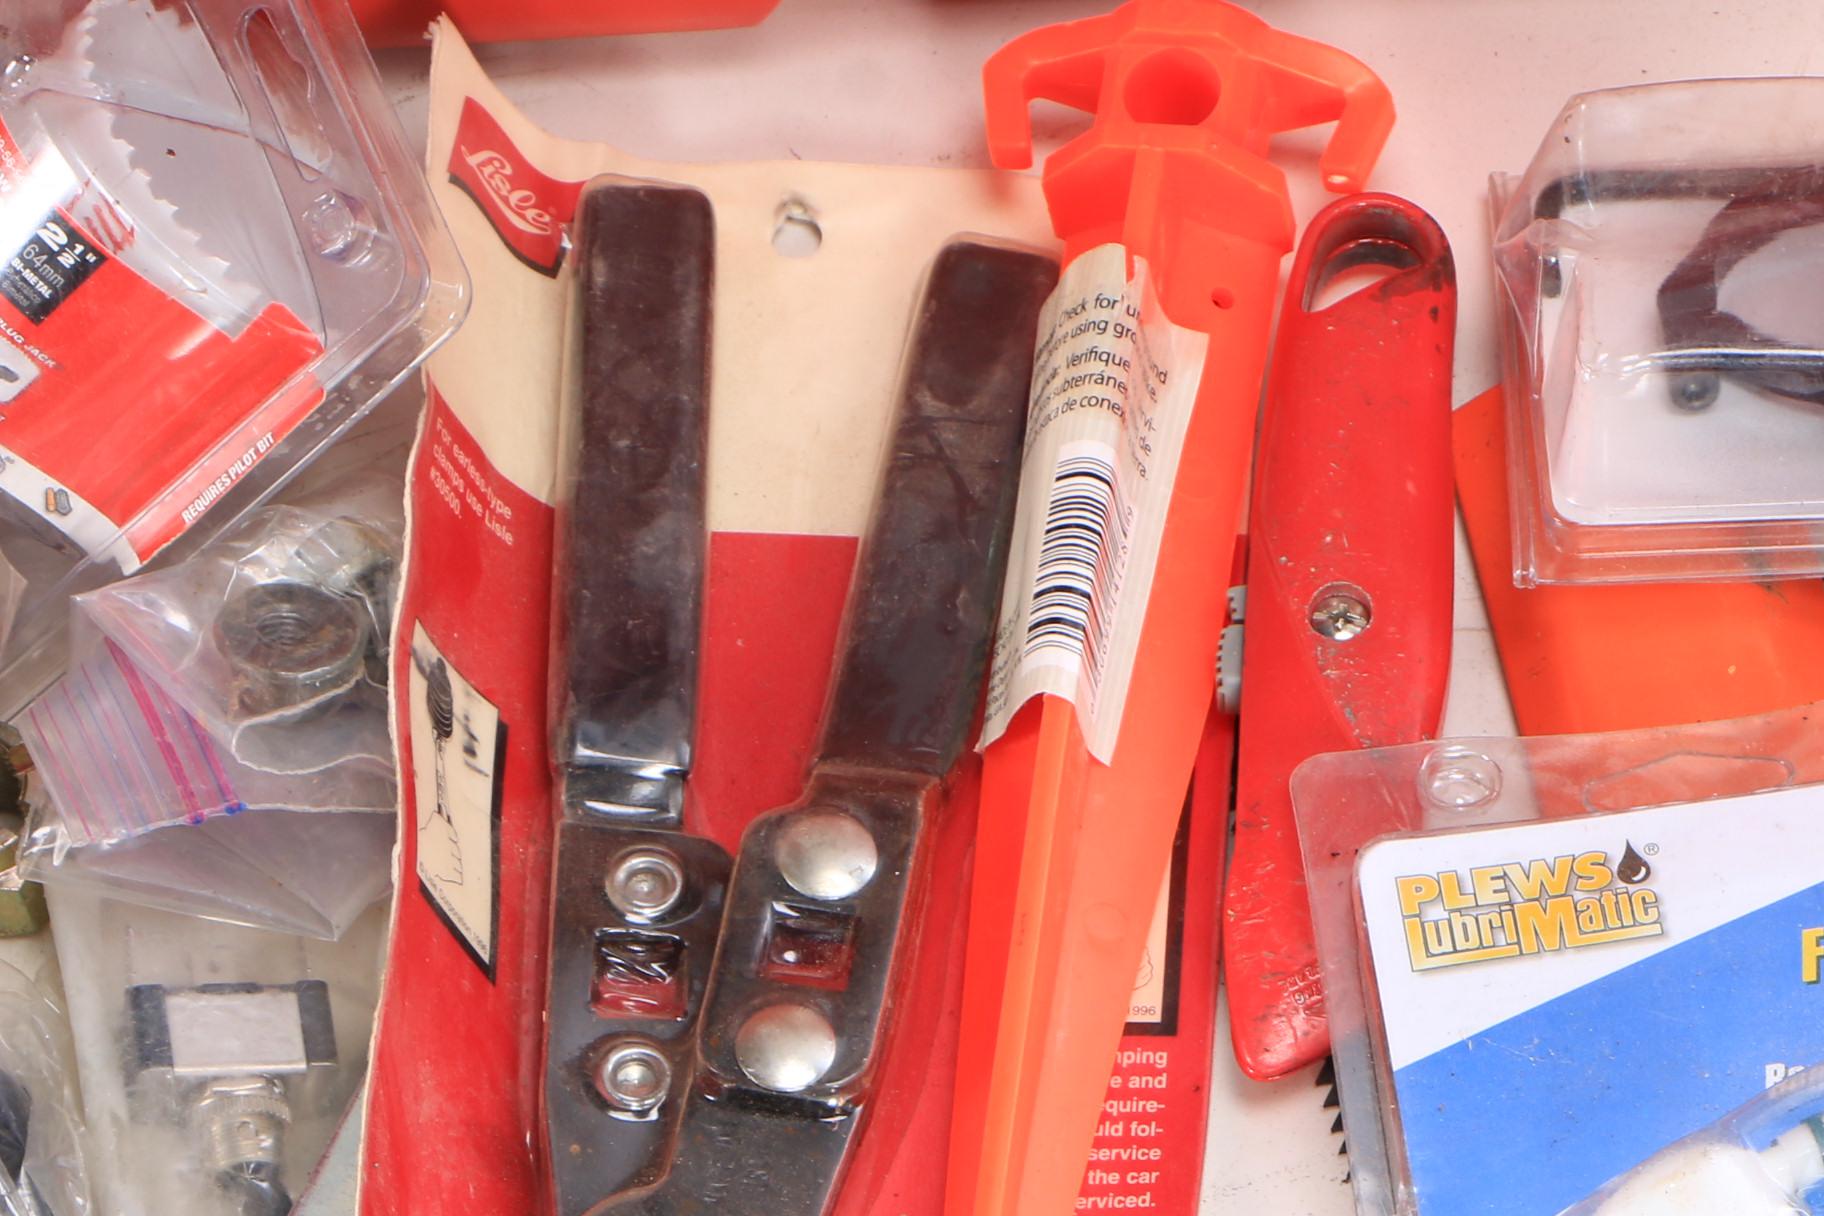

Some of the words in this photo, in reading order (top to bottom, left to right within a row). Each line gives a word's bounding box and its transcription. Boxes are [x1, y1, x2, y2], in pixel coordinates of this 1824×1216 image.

[461, 145, 551, 234] Lisle
[11, 257, 53, 299] BI-METAL
[23, 244, 64, 288] 64mm
[1094, 293, 1119, 310] for
[1071, 318, 1108, 338] using
[1066, 346, 1131, 374] Verifique
[181, 474, 232, 524] REQUIRES
[229, 448, 256, 480] PILOT
[255, 432, 276, 454] BIT
[436, 416, 452, 445] For
[453, 444, 512, 520] earless-type
[433, 444, 465, 493] clamps
[466, 488, 483, 517] use
[485, 509, 513, 546] Lisle
[1395, 851, 1614, 917] PLEWS
[1403, 887, 1663, 973] LubriMatic
[1128, 1072, 1167, 1089] and
[1130, 1121, 1164, 1138] fol-
[1087, 1146, 1162, 1162] service
[1087, 1170, 1120, 1185] the
[1127, 1171, 1160, 1185] car
[1075, 1193, 1156, 1210] erviced.
